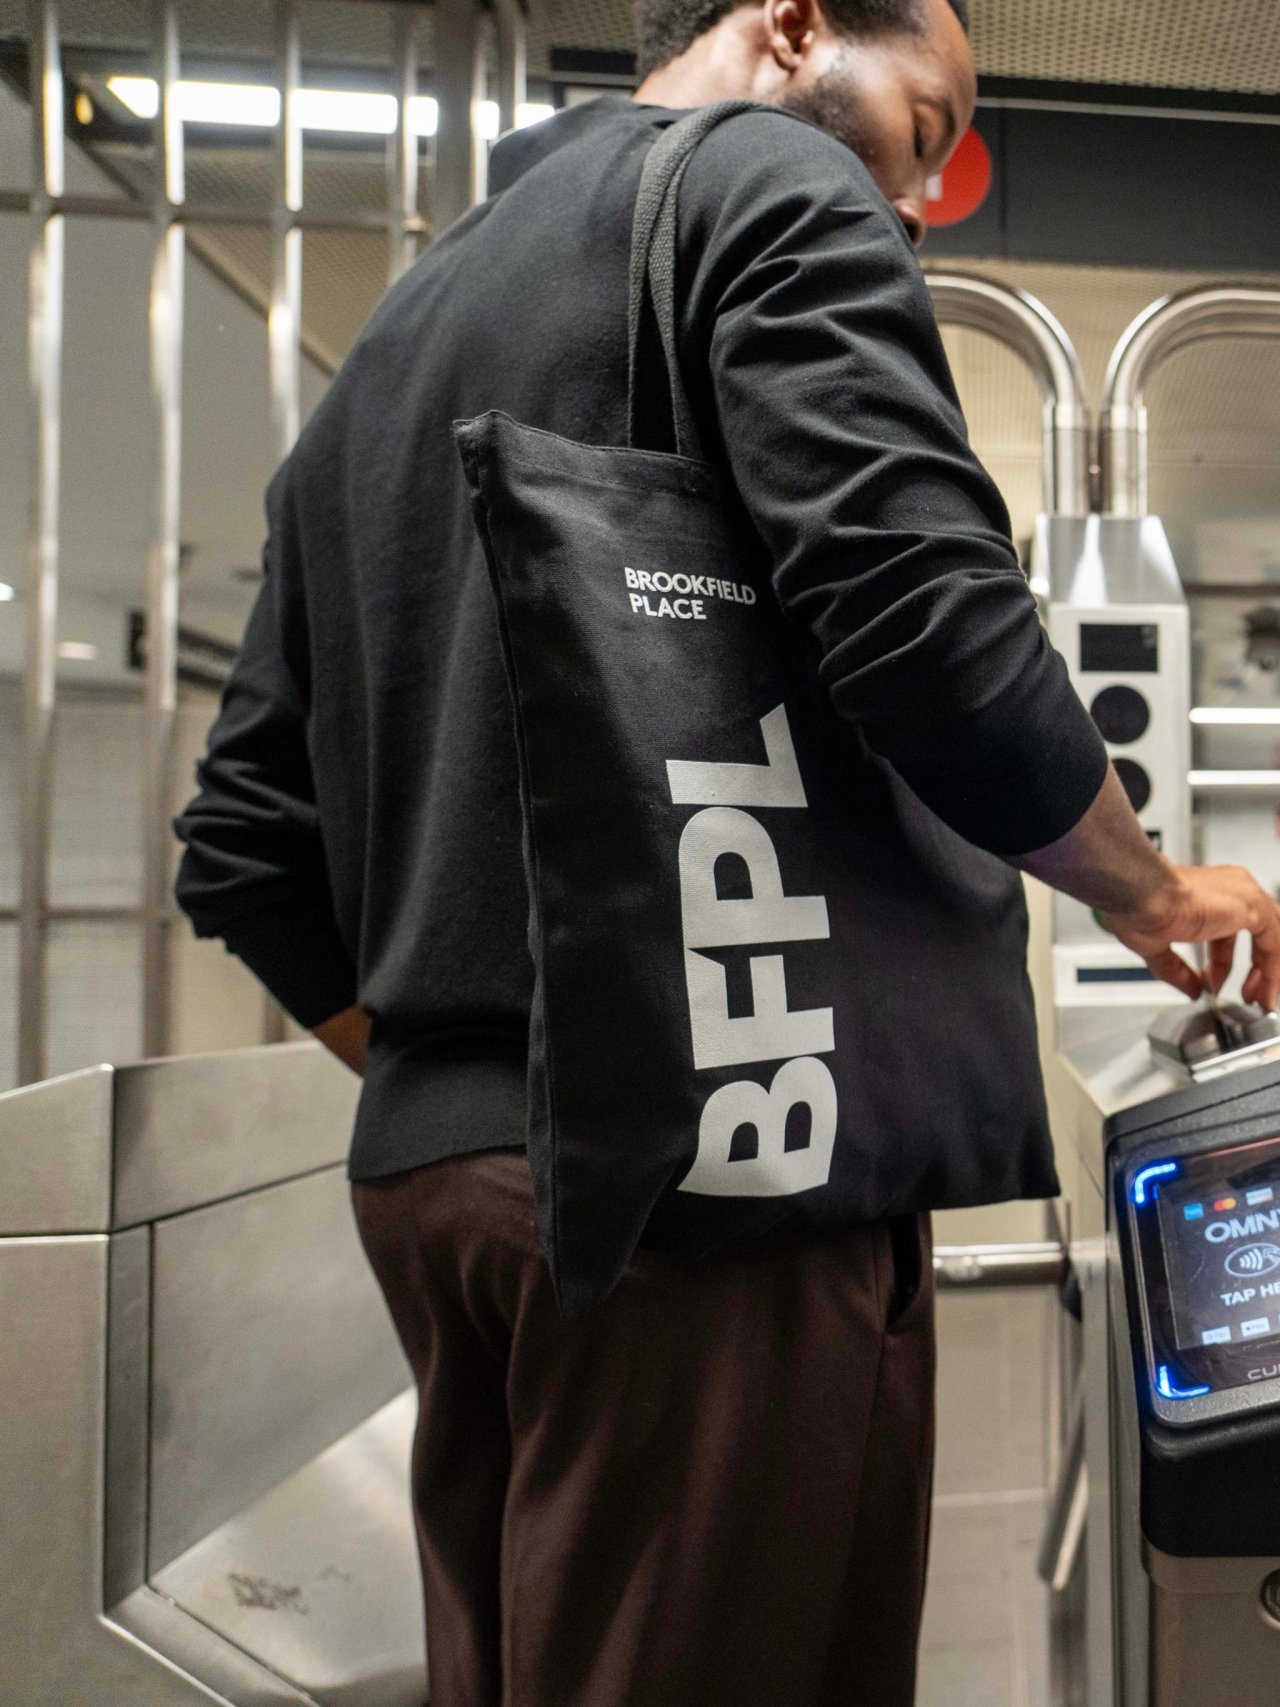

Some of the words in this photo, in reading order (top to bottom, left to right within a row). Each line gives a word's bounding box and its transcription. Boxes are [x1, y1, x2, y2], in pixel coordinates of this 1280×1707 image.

[624, 566, 757, 605] BROOKFIELD
[629, 593, 707, 620] PLACE
[665, 702, 838, 1197] BFPL
[1220, 1287, 1256, 1306] TAP
